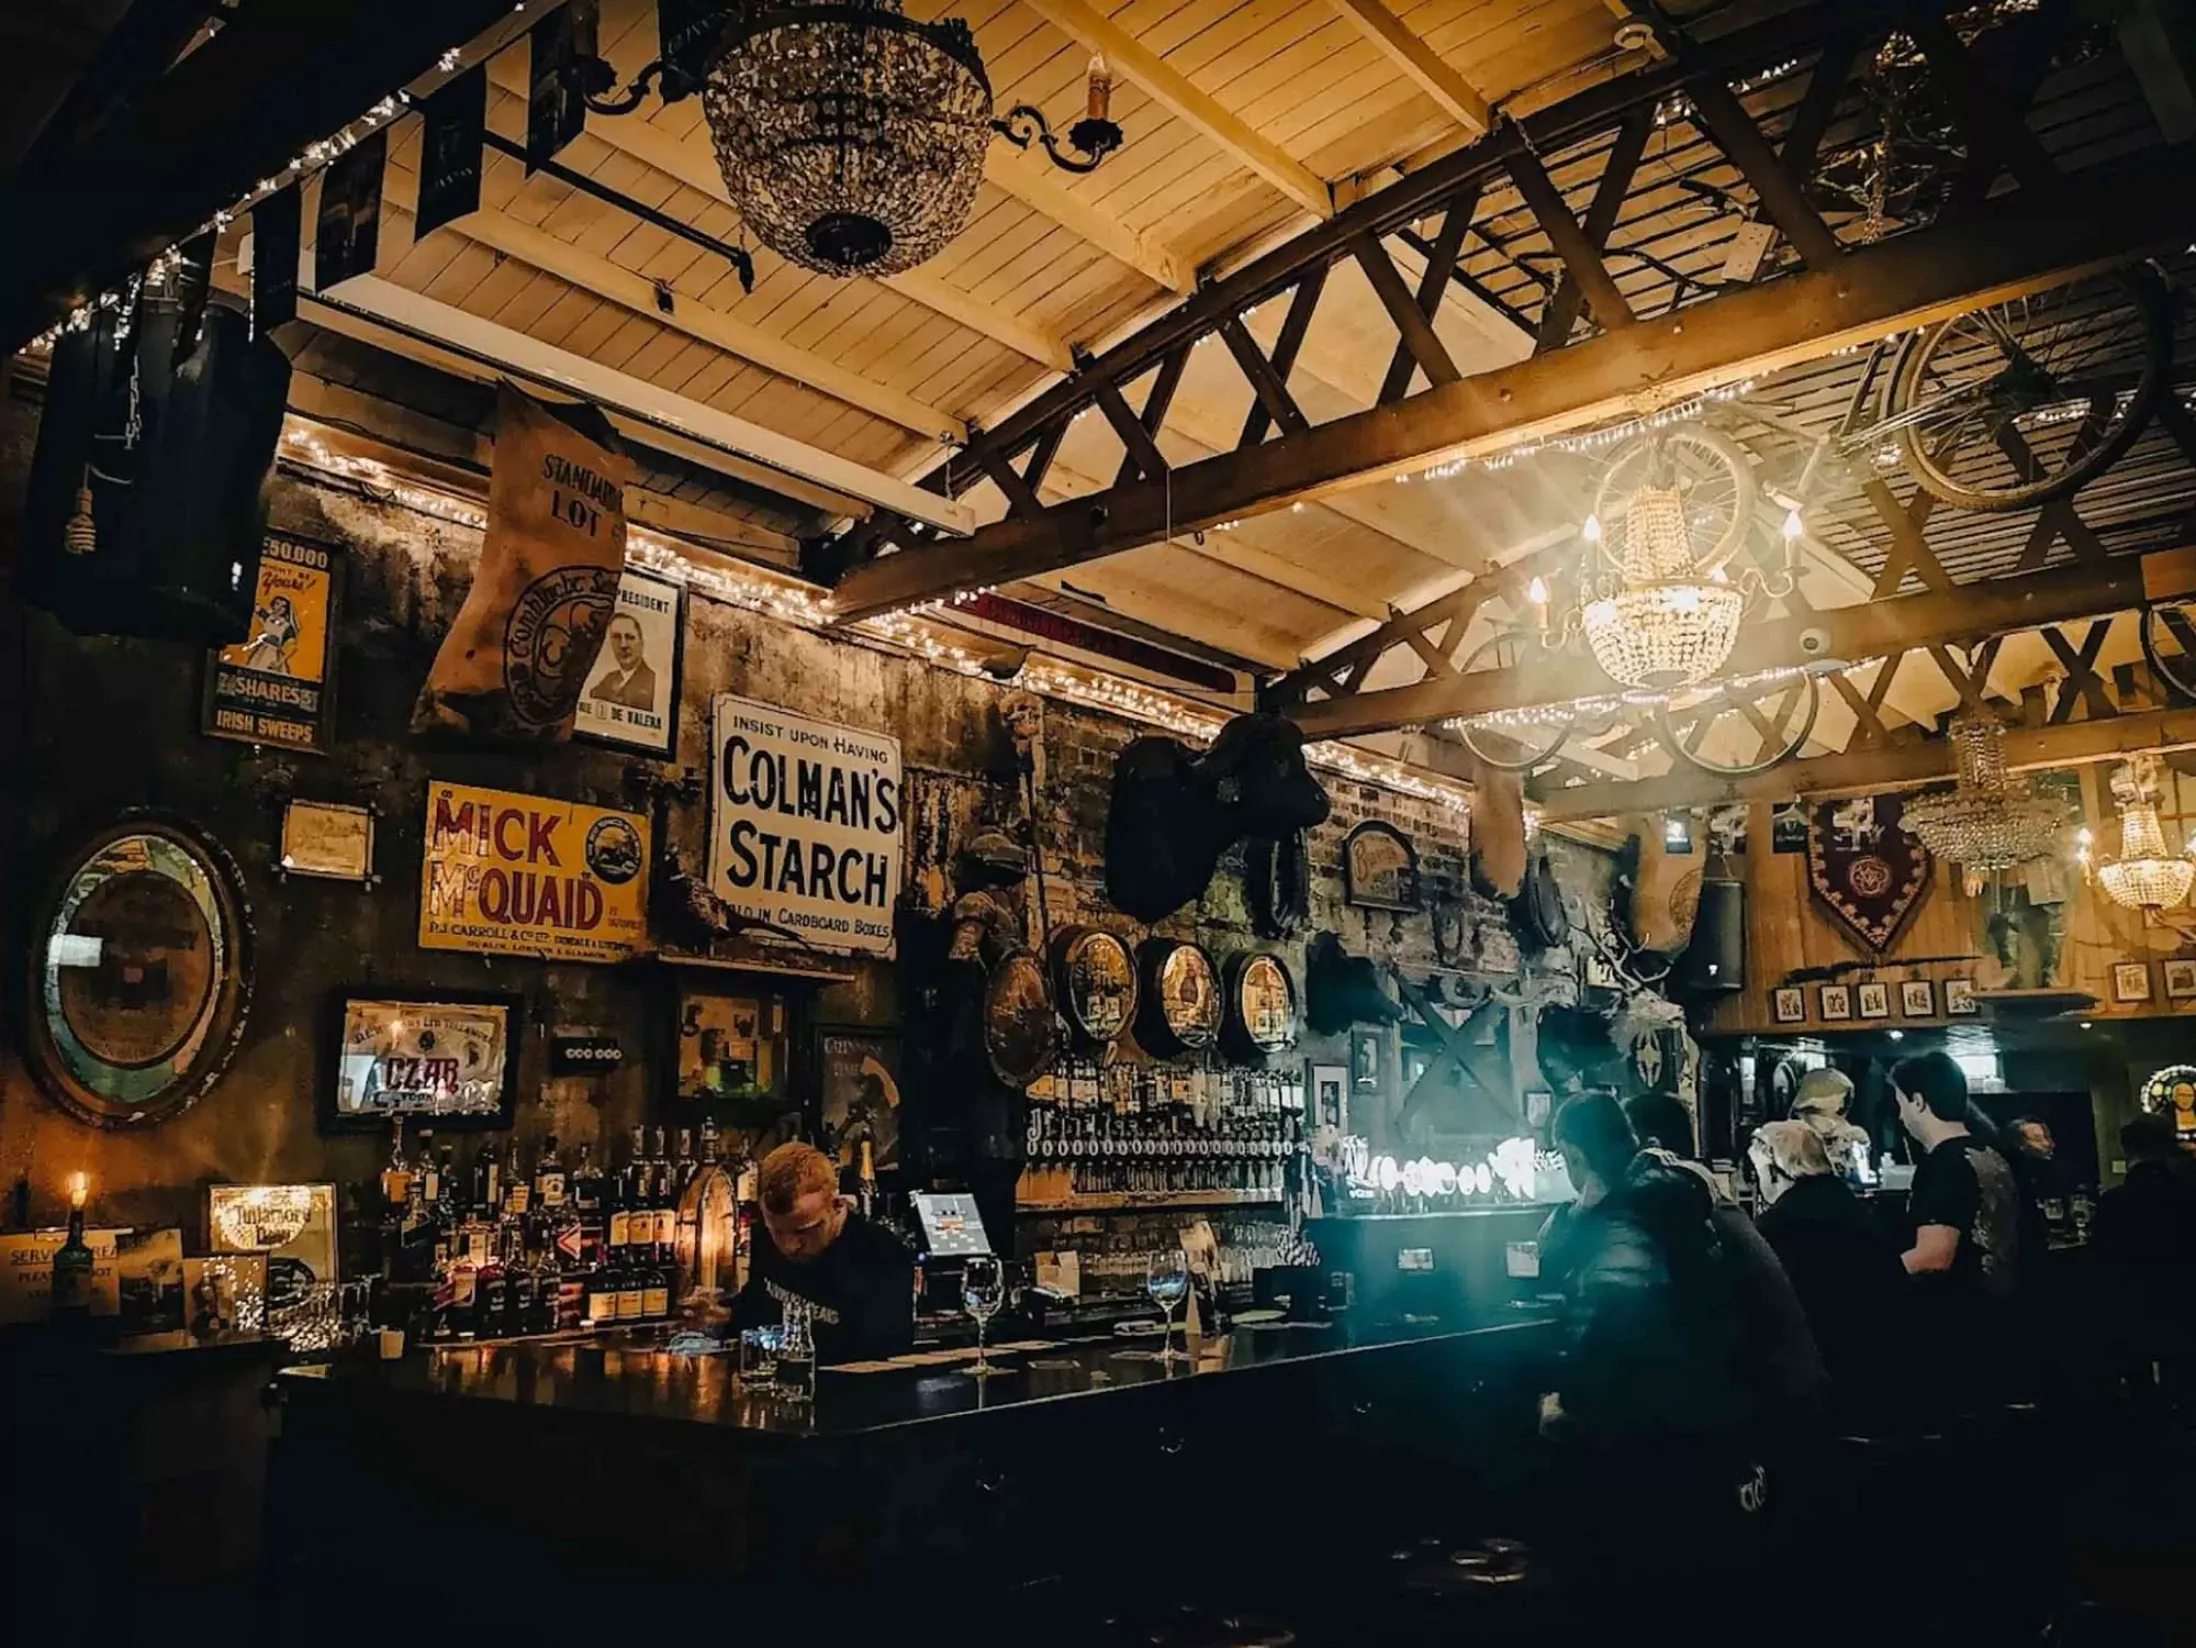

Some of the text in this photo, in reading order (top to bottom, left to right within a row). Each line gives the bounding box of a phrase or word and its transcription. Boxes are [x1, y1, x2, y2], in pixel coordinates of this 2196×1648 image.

[551, 490, 602, 537] LOT
[235, 676, 300, 705] SHARES
[216, 709, 314, 744] IRISH SWEEPS
[733, 715, 889, 765] INSIST UPON HAVING
[723, 735, 898, 835] COLMAN'S
[434, 798, 563, 868] MICK
[726, 818, 889, 908] STARCH
[450, 923, 509, 940] CARROLL
[777, 906, 850, 933] CARDBOARD
[853, 918, 891, 938] BOXES
[386, 1057, 460, 1095] CZAR
[10, 1248, 54, 1262] SERV
